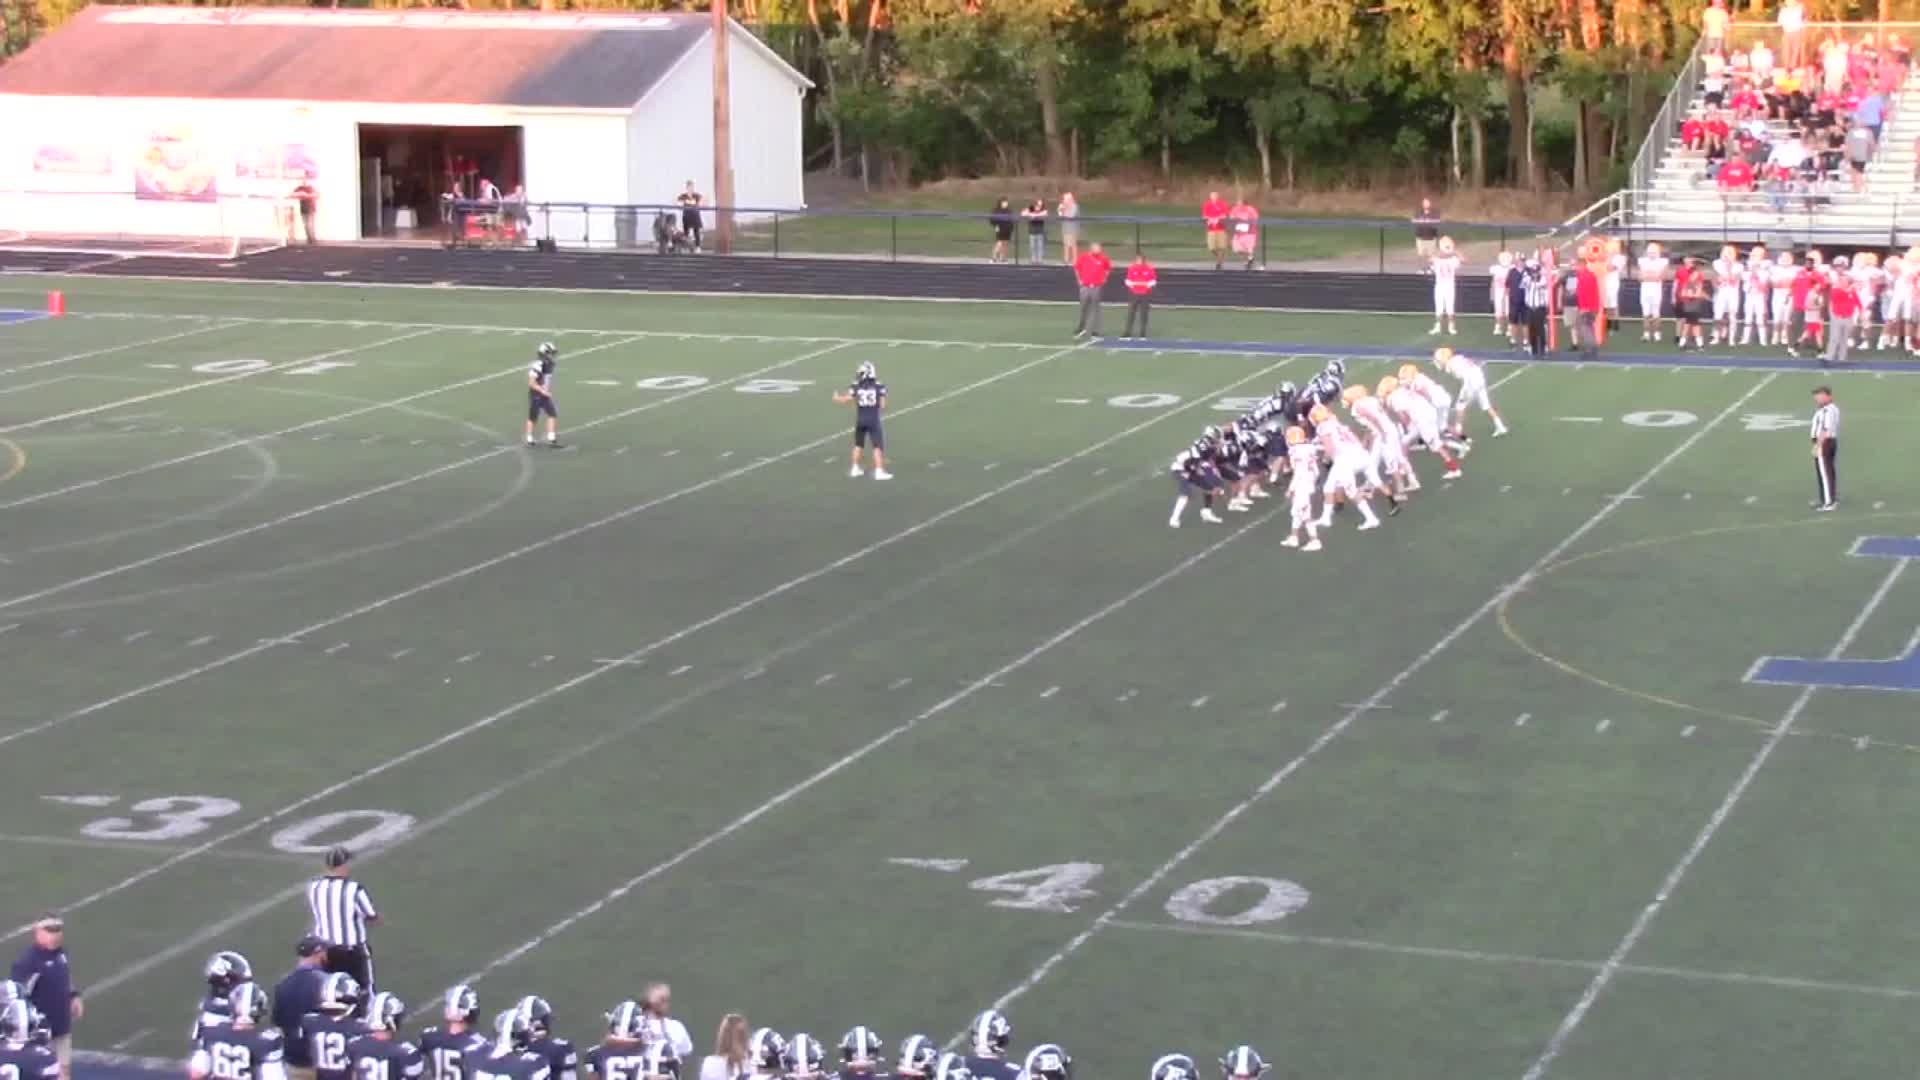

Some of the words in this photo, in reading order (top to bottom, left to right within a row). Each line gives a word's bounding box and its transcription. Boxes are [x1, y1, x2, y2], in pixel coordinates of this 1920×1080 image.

[857, 388, 877, 408] 33
[213, 1041, 252, 1080] 62
[315, 1031, 347, 1070] 12
[434, 1047, 463, 1080] 15
